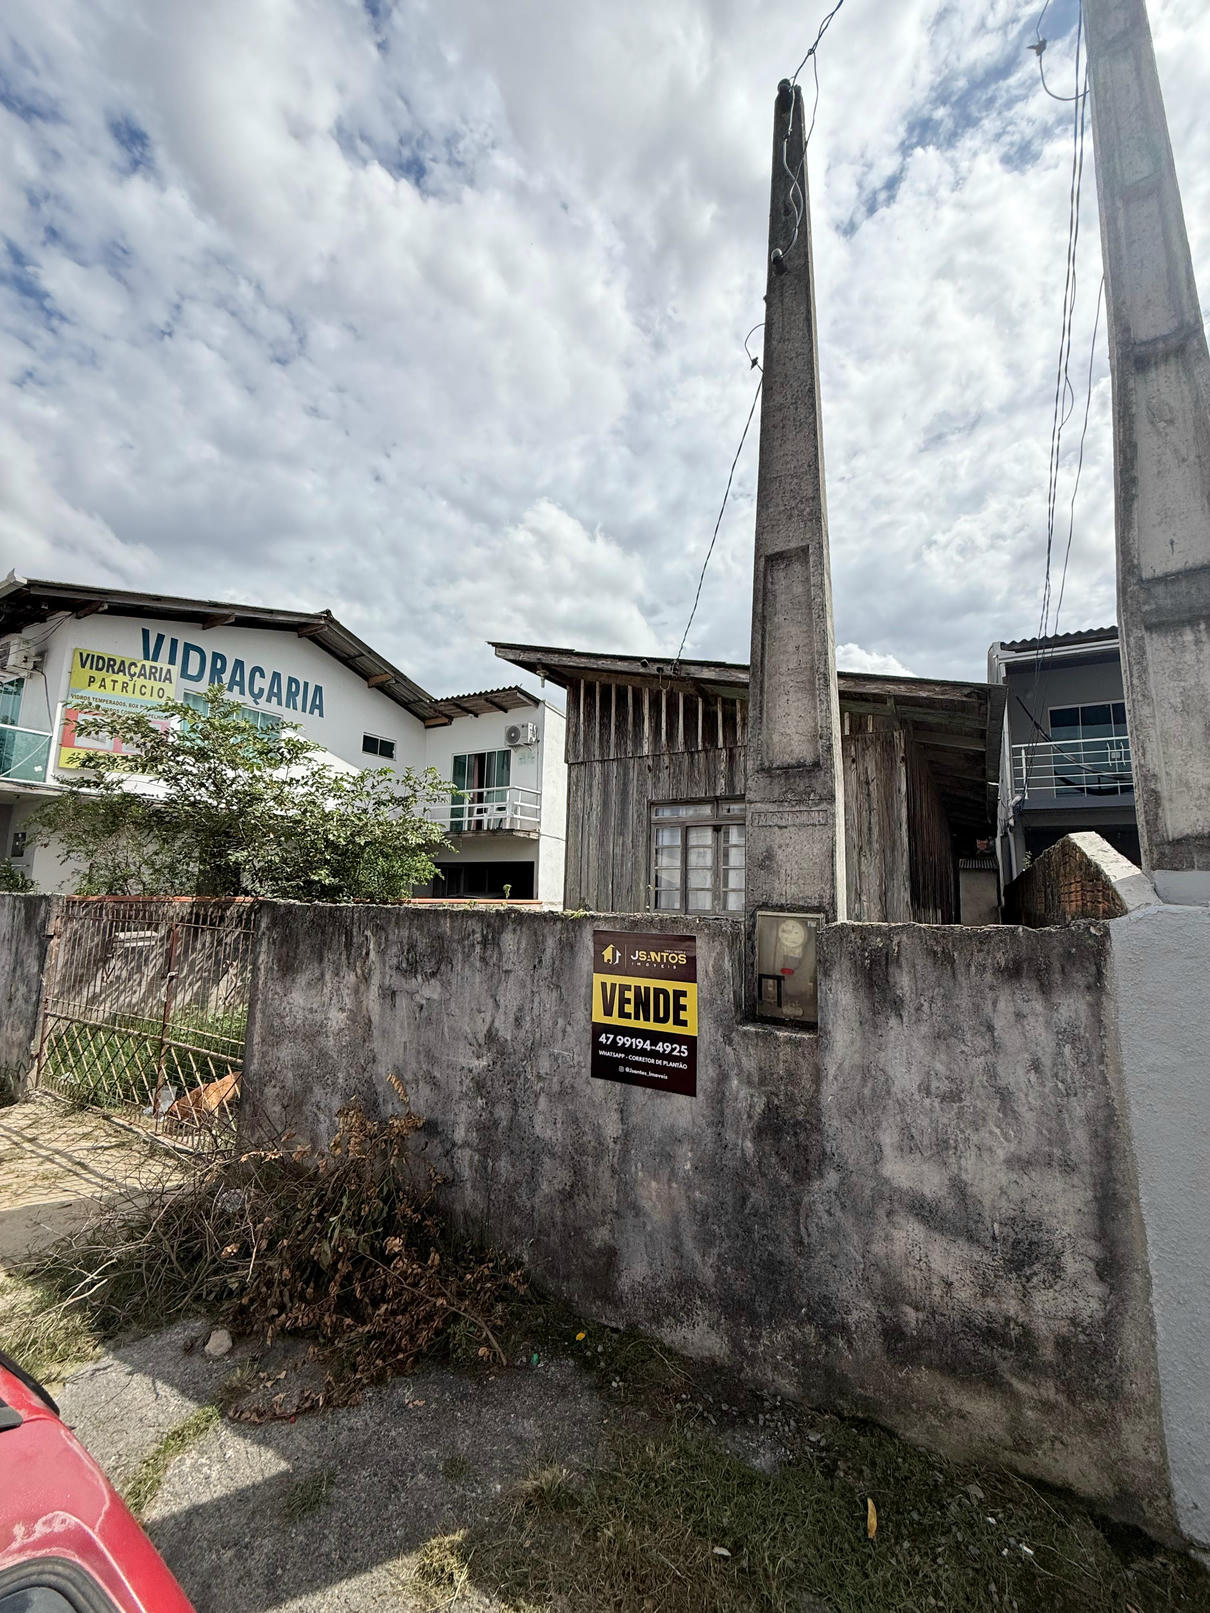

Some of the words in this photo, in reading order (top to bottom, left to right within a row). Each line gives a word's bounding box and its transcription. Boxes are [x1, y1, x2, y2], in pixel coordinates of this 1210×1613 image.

[79, 652, 173, 684] VIDRAÇARIA
[142, 628, 325, 718] VIDRAÇARIA
[87, 675, 165, 699] PATRÍCIO
[601, 981, 688, 1028] VENDE
[599, 1033, 614, 1045] 47
[616, 1035, 688, 1057] 99194-4925
[599, 1049, 625, 1059] WHATSAPP
[628, 1054, 655, 1064] CORRETOR
[663, 1060, 688, 1070] PLANTÃO
